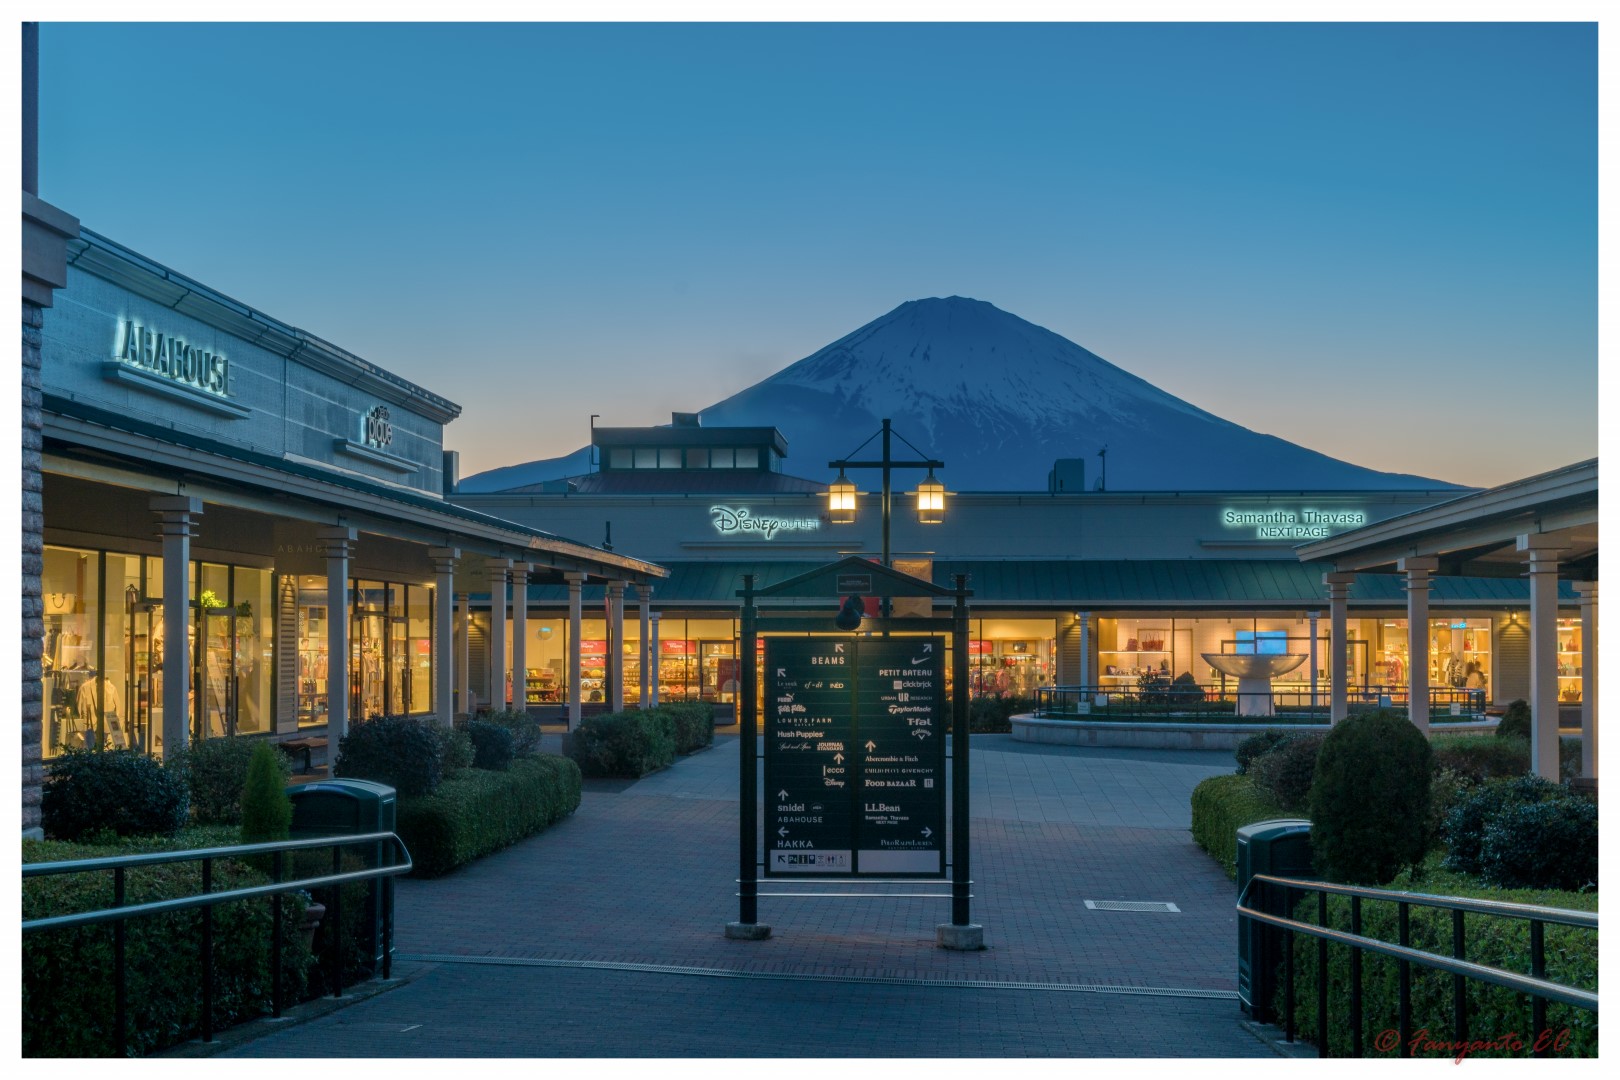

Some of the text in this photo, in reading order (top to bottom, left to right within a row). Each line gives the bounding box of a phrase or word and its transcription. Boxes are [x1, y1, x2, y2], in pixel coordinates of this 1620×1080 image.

[119, 319, 236, 397] ABAHOUSE
[1226, 511, 1363, 523] Samantha Thavasa
[712, 507, 818, 538] Disney OUTLET
[1260, 527, 1329, 536] NEXT PAGE
[812, 656, 845, 665] BEAMS
[898, 692, 910, 702] UR
[888, 704, 932, 714] TaylorMade
[865, 803, 900, 812] L.L.Bean
